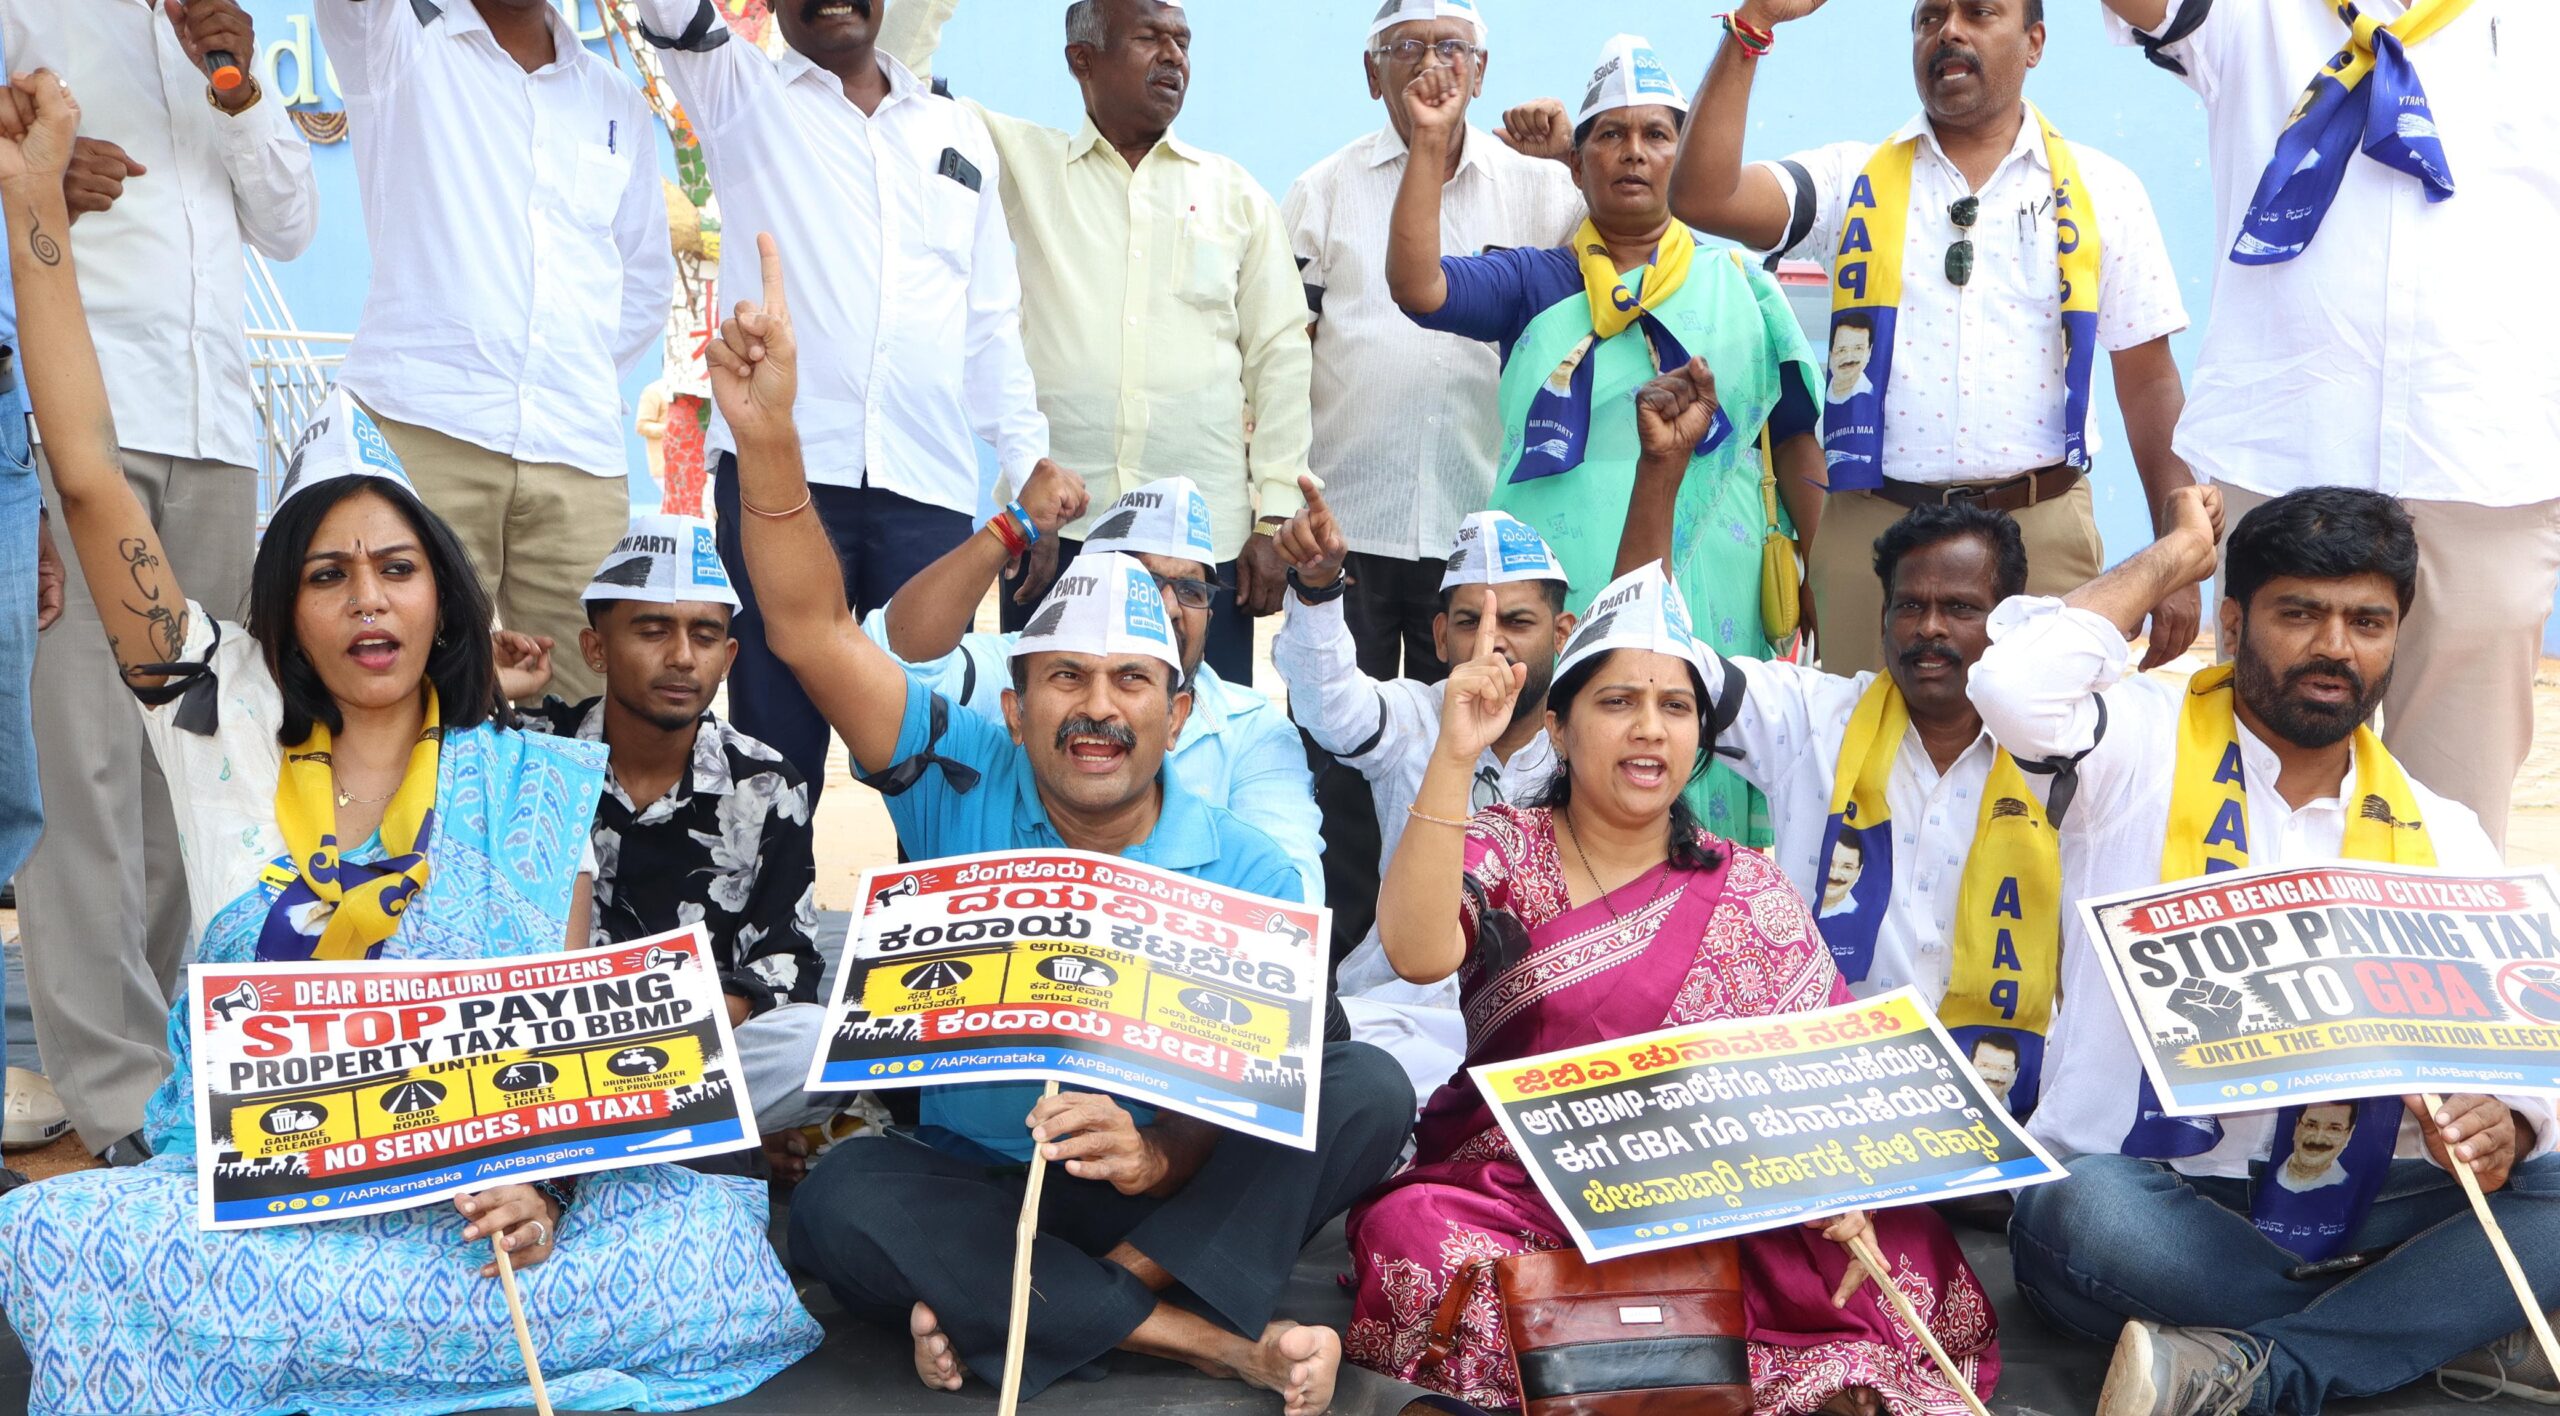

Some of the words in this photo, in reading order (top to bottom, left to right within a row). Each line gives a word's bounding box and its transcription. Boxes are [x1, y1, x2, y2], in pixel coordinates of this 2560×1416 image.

[1553, 421, 1574, 440] PARTY
[1119, 492, 1164, 509] PARTY
[633, 535, 677, 555] PARTY
[1054, 576, 1098, 598] PARTY
[1129, 579, 1161, 621] aap
[1597, 581, 1644, 616] PARTY
[955, 860, 1085, 884] ಬೆಂಗಳೂರು
[2147, 895, 2224, 930] DEAR
[2225, 875, 2383, 914] BENGALURU
[2384, 879, 2507, 908] CITIZENS
[879, 911, 1092, 952] ಕಂದಾಯ
[2129, 918, 2278, 988] STOP
[2286, 906, 2476, 959] PAYING
[2464, 912, 2560, 959] TAX
[295, 980, 359, 1005] DEAR
[364, 972, 502, 1002] BENGALURU
[509, 958, 613, 988] CITIZENS
[2264, 965, 2355, 1022] TO
[2352, 960, 2492, 1018] GBA
[242, 1005, 447, 1058] STOP
[459, 972, 675, 1030] PAYING
[229, 1038, 433, 1091] PROPERTY
[443, 1025, 519, 1057] TAX
[528, 1019, 575, 1044] TO
[585, 999, 693, 1039] BBMP
[937, 1008, 1111, 1038] ಕಂದಾಯ
[1122, 1023, 1229, 1073] ಬೇಡ!
[2196, 1038, 2272, 1065] UNTIL
[2273, 1029, 2325, 1053] THE
[2327, 1023, 2488, 1045] CORPORATION
[428, 1052, 506, 1075] UNTIL
[930, 1052, 1046, 1070] /AAPKarnataka
[1057, 1054, 1169, 1090] /AAPBangalore
[1513, 1060, 1622, 1094] ಜಿಬಿಎ
[1628, 1024, 1798, 1071] ಚುನಾವಣೆ
[503, 1086, 554, 1101] STREET
[602, 1075, 649, 1087] DRINKING
[649, 1070, 686, 1081] WATER
[614, 1085, 625, 1093] IS
[625, 1078, 677, 1092] PROVIDED
[2287, 1066, 2403, 1090] /AAPKarnataka
[2416, 1065, 2524, 1081] /AAPBangalore
[395, 1108, 435, 1122] GOOD
[506, 1094, 556, 1108] LIGHTS
[1519, 1100, 1574, 1136] ಆಗ
[264, 1129, 326, 1146] GARBAGE
[324, 1143, 367, 1171] NO
[375, 1113, 531, 1162] SERVICES,
[536, 1103, 579, 1128] NO
[585, 1093, 654, 1121] TAX!
[392, 1115, 440, 1131] ROADS
[260, 1147, 272, 1155] IS
[276, 1136, 332, 1152] CLEARED
[1618, 1125, 1694, 1163] GBA
[338, 1170, 463, 1204] /AAPKarnataka
[476, 1145, 595, 1177] /AAPBangalore
[1697, 1203, 1803, 1229] /AAPKarnataka
